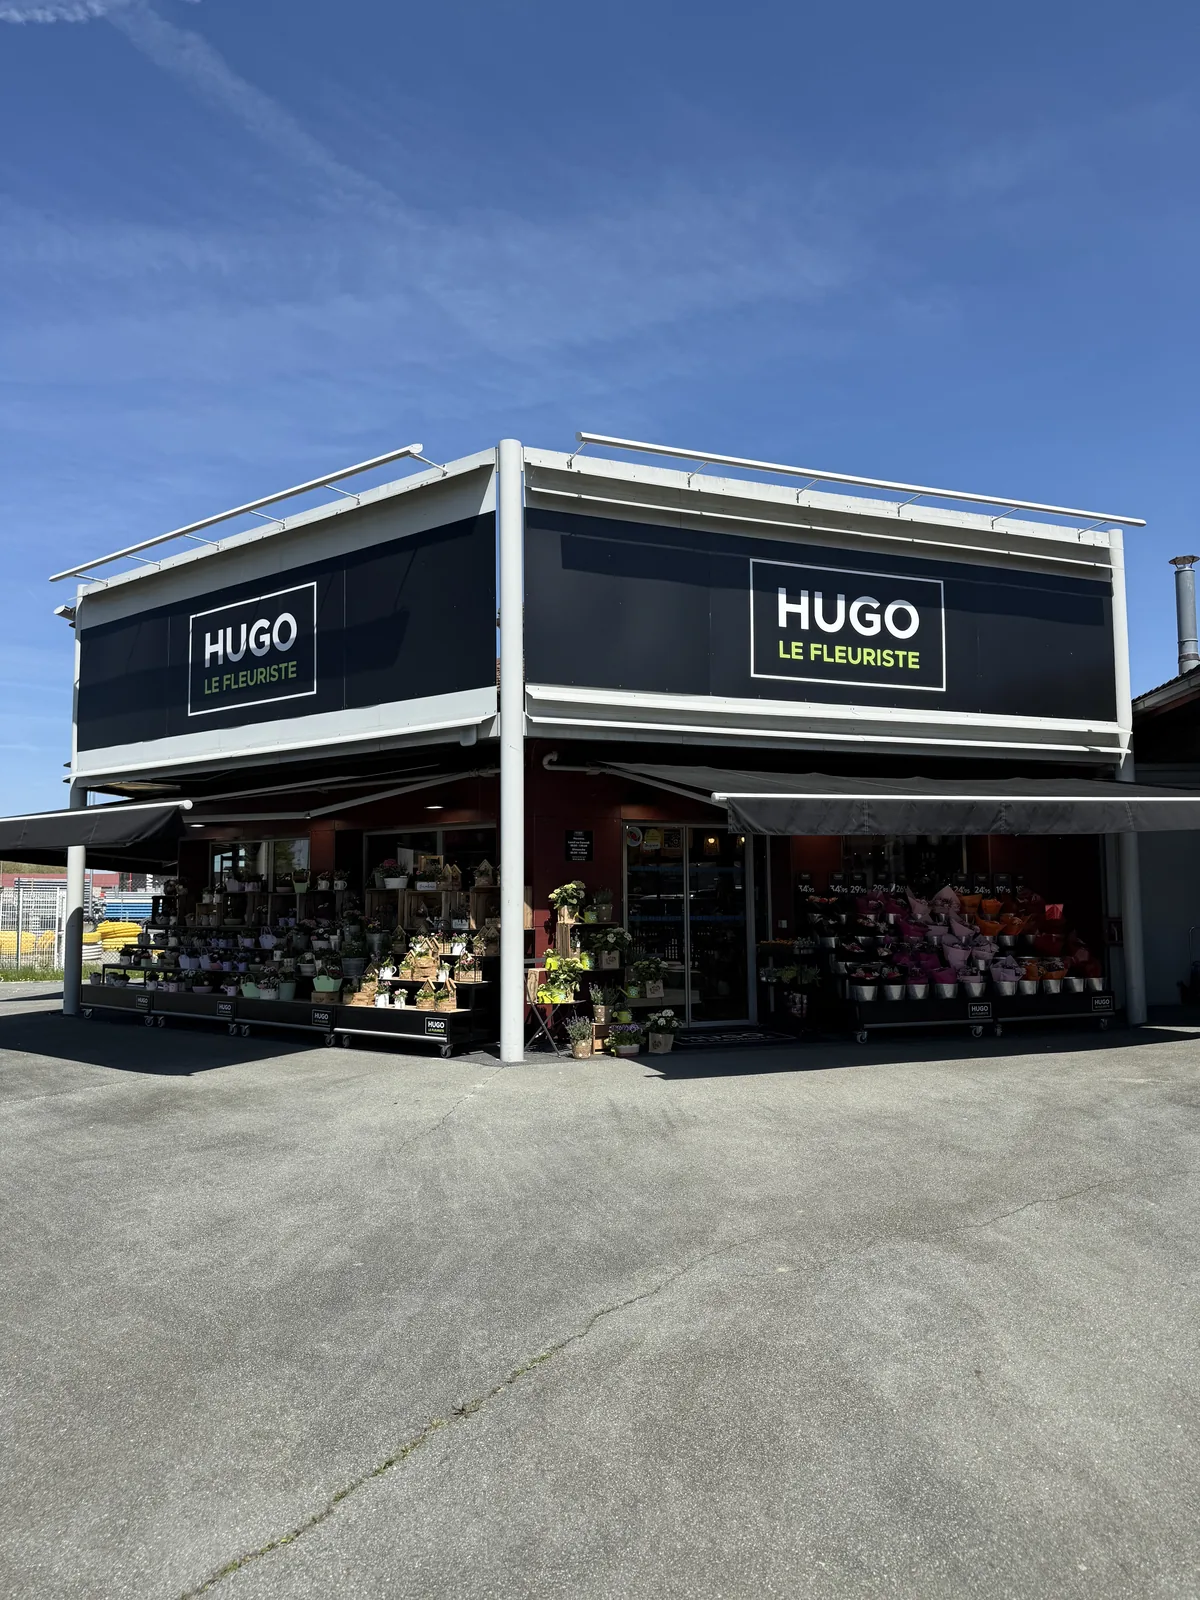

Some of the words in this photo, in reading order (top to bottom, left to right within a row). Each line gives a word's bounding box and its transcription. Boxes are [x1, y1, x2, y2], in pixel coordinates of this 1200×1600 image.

[778, 587, 920, 640] HUGO
[205, 612, 298, 668] HUGO
[779, 640, 804, 660] LE
[810, 643, 920, 669] FLEURISTE
[204, 676, 220, 695] LE
[223, 660, 297, 691] FLEURISTE
[314, 1012, 329, 1020] HUGO
[428, 1021, 445, 1029] HUGO
